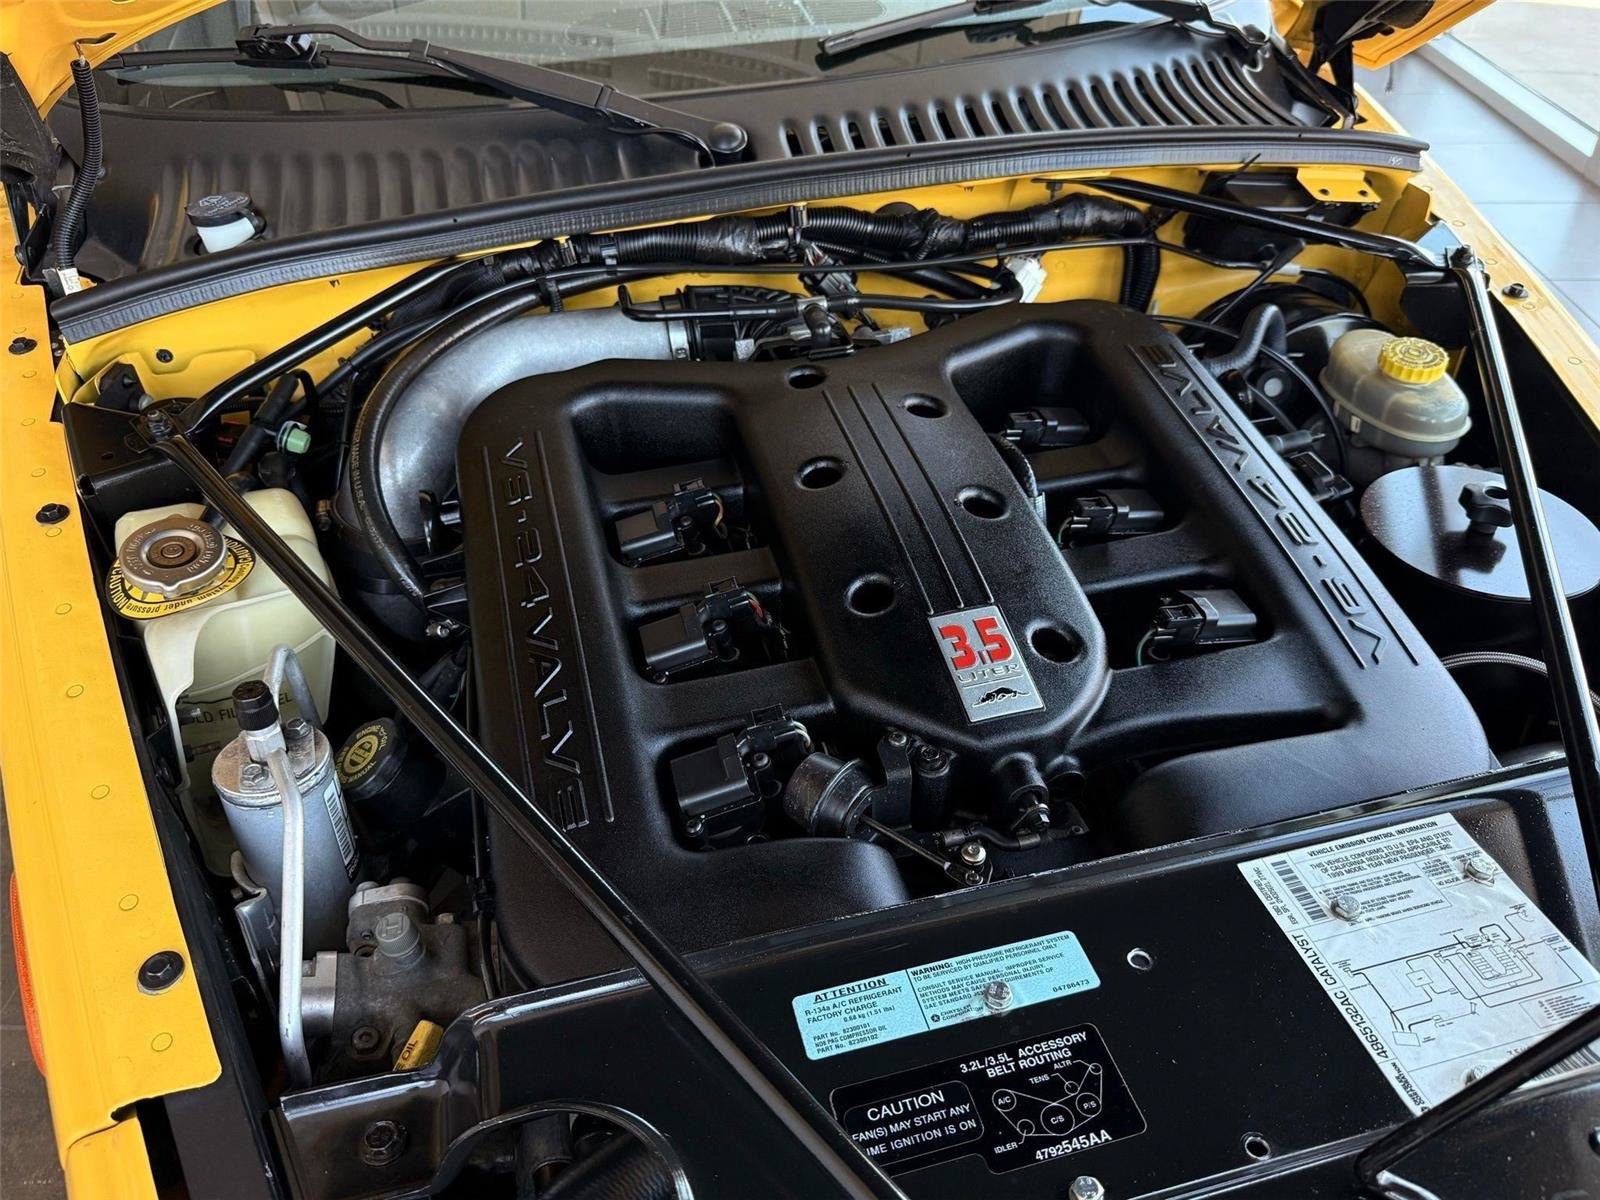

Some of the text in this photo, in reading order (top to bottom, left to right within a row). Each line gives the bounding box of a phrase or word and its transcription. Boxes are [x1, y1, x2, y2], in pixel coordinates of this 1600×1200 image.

[126, 602, 162, 614] pressure
[164, 598, 193, 611] under
[938, 616, 1014, 672] 3.5
[957, 663, 1021, 684] LITER
[1307, 821, 1438, 857] VEHICLE EMISSION CONTROL INFORMATION
[1309, 861, 1325, 869] THIS
[1324, 855, 1350, 866] VEHICLE
[1349, 847, 1384, 859] CONFORMS
[1392, 841, 1407, 849] U.S.
[1432, 830, 1453, 839] STATE
[1326, 870, 1344, 878] 1999
[1343, 864, 1367, 874] MODEL
[1366, 860, 1384, 868] YEAR
[1383, 856, 1400, 864] NEW
[1398, 847, 1436, 860] PASSENGER
[1329, 858, 1365, 871] CALIFORNIA
[1364, 848, 1407, 862] REGULATIONS
[1405, 839, 1443, 852] APPLICABLE
[910, 933, 1070, 977] WARNING: HIGH-PRESSURE REFRIGERANT SYSTEM
[931, 965, 963, 977] SERVICED
[972, 955, 1005, 967] QUALIFIED
[1004, 946, 1041, 960] PERSONNEL
[1040, 942, 1058, 951] ONLY
[1292, 932, 1337, 987] CATALYST
[916, 980, 947, 992] CONSULT
[946, 974, 974, 985] SERVICE
[1004, 958, 1038, 971] IMPROPER
[1037, 951, 1065, 962] SERVICE
[919, 986, 950, 998] METHODS
[950, 982, 965, 990] MAY
[965, 977, 987, 986] CAUSE
[987, 968, 1021, 981] PERSONAL
[804, 986, 903, 1016] R-134a A/C REFRIGERANT
[812, 978, 887, 1001] ATTENTION
[921, 993, 948, 1004] SYSTEM
[947, 987, 970, 997] MEETS
[937, 993, 972, 1006] STANDARD
[806, 1000, 878, 1024] FACTORY CHARGE
[1334, 989, 1389, 1060] 4865132AC
[812, 1032, 828, 1041] PART
[839, 1026, 877, 1041] COMPRESSOR
[402, 1040, 418, 1060] OIL
[816, 1045, 833, 1054] PART
[959, 1031, 1088, 1074] 3.2L/3.5L ACCESSORY
[986, 1047, 1073, 1079] BELT ROUTING
[1029, 1073, 1051, 1085] TENS
[1053, 1059, 1072, 1071] ALTR
[867, 1089, 945, 1121] CAUTION
[998, 1096, 1012, 1106] A/C
[889, 1119, 911, 1134] MAY
[914, 1109, 947, 1126] START
[949, 1103, 971, 1117] ANY
[1050, 1115, 1065, 1125] C/S
[865, 1118, 977, 1157] IME IGNITION IS ON
[994, 1141, 1018, 1154] IDLER
[1035, 1129, 1113, 1161] 4792545AA
